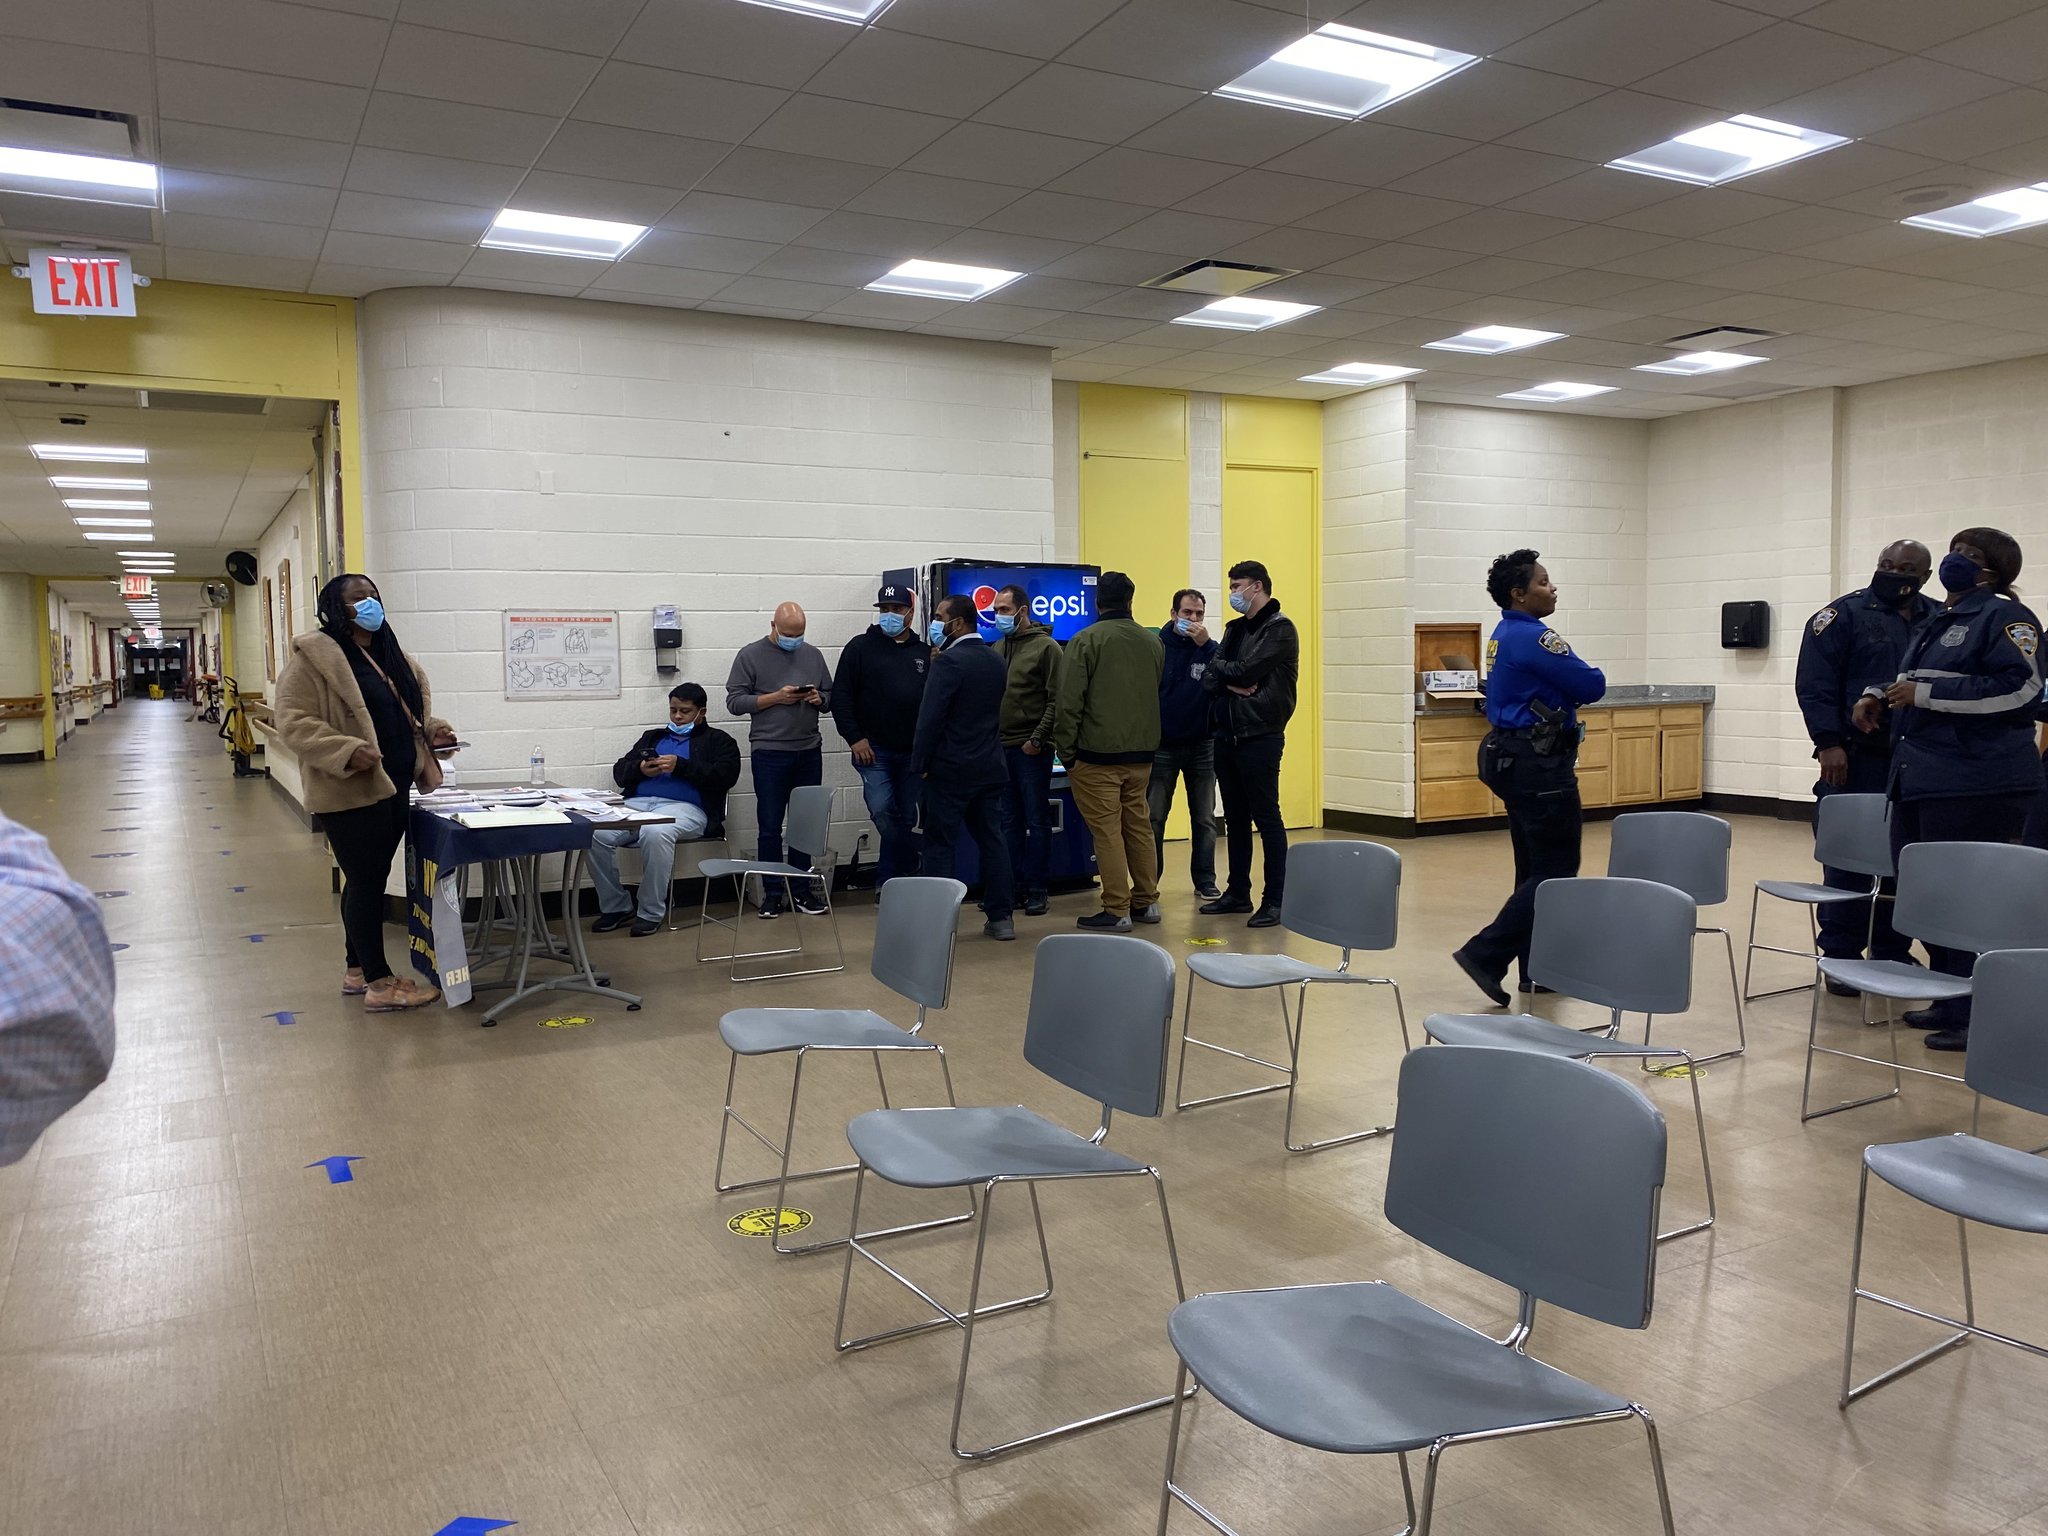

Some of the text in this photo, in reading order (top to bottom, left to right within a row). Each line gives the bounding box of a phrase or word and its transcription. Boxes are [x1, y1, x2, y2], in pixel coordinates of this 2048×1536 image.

[48, 256, 120, 307] EXIT
[126, 576, 147, 592] EXIT
[885, 586, 895, 596] NY
[1031, 591, 1086, 622] epsi
